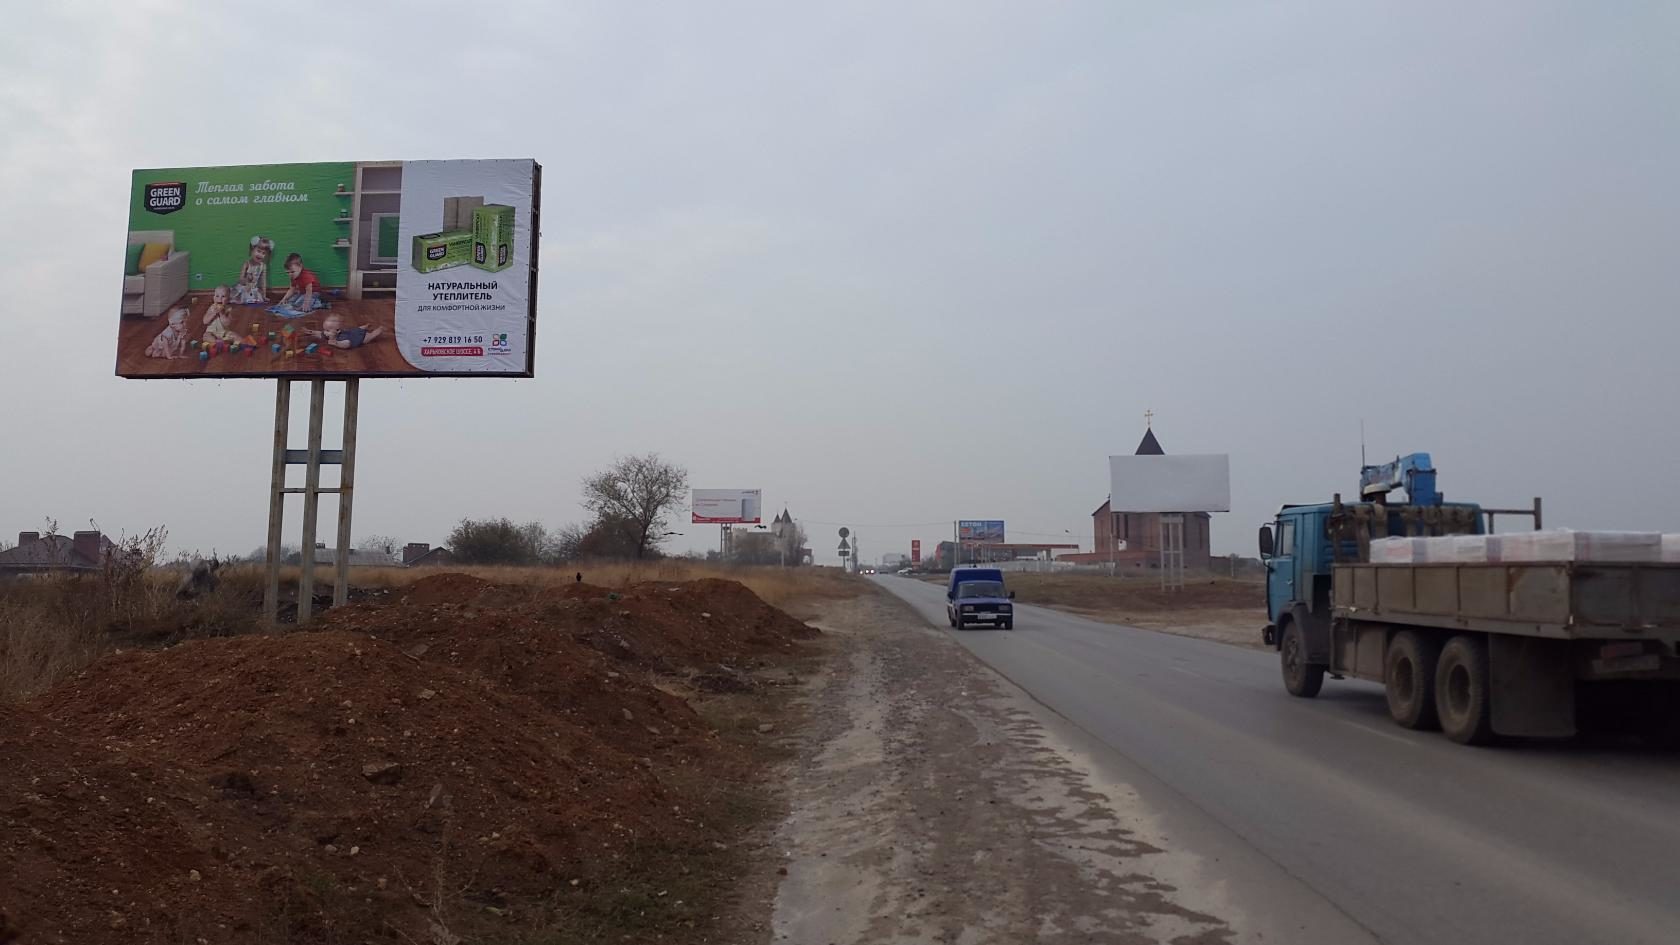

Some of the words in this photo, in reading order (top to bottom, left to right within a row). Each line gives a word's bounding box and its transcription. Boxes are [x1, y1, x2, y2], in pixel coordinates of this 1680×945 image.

[195, 181, 244, 194] Теплая
[249, 179, 295, 191] забота
[150, 187, 180, 197] GREEN
[149, 197, 181, 206] GUARD
[195, 198, 202, 206] о
[207, 195, 248, 205] самом
[253, 191, 309, 203] главном
[428, 281, 498, 290] НАТУРАЛЬНЫЙ
[433, 293, 492, 301] УТЕПЛИТЕЛЬ
